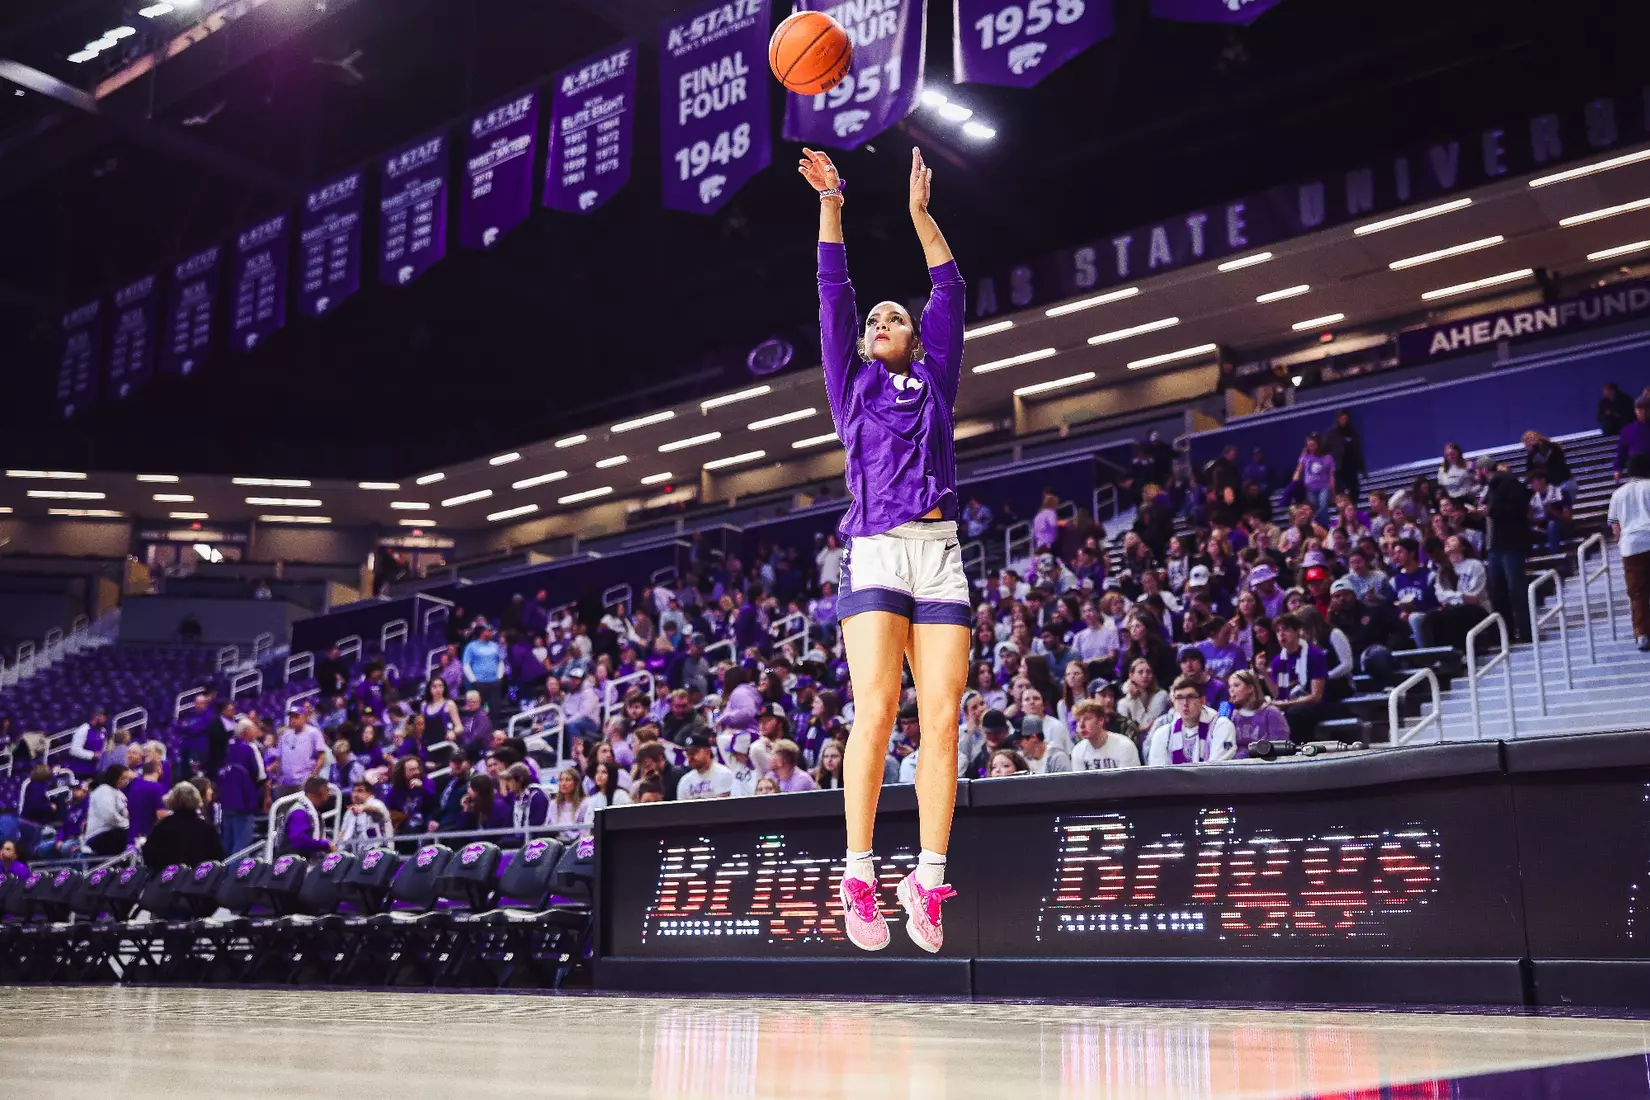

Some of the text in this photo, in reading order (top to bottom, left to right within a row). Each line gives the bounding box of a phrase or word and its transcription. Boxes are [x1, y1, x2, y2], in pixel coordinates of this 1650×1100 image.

[667, 0, 762, 50] K-STATE
[975, 0, 1085, 50] 1958
[679, 51, 750, 100] FINAL
[813, 56, 901, 112] 1951
[679, 77, 748, 126] FOUR
[674, 122, 751, 181] 1948
[1073, 86, 1650, 287] STATE UNIVERS
